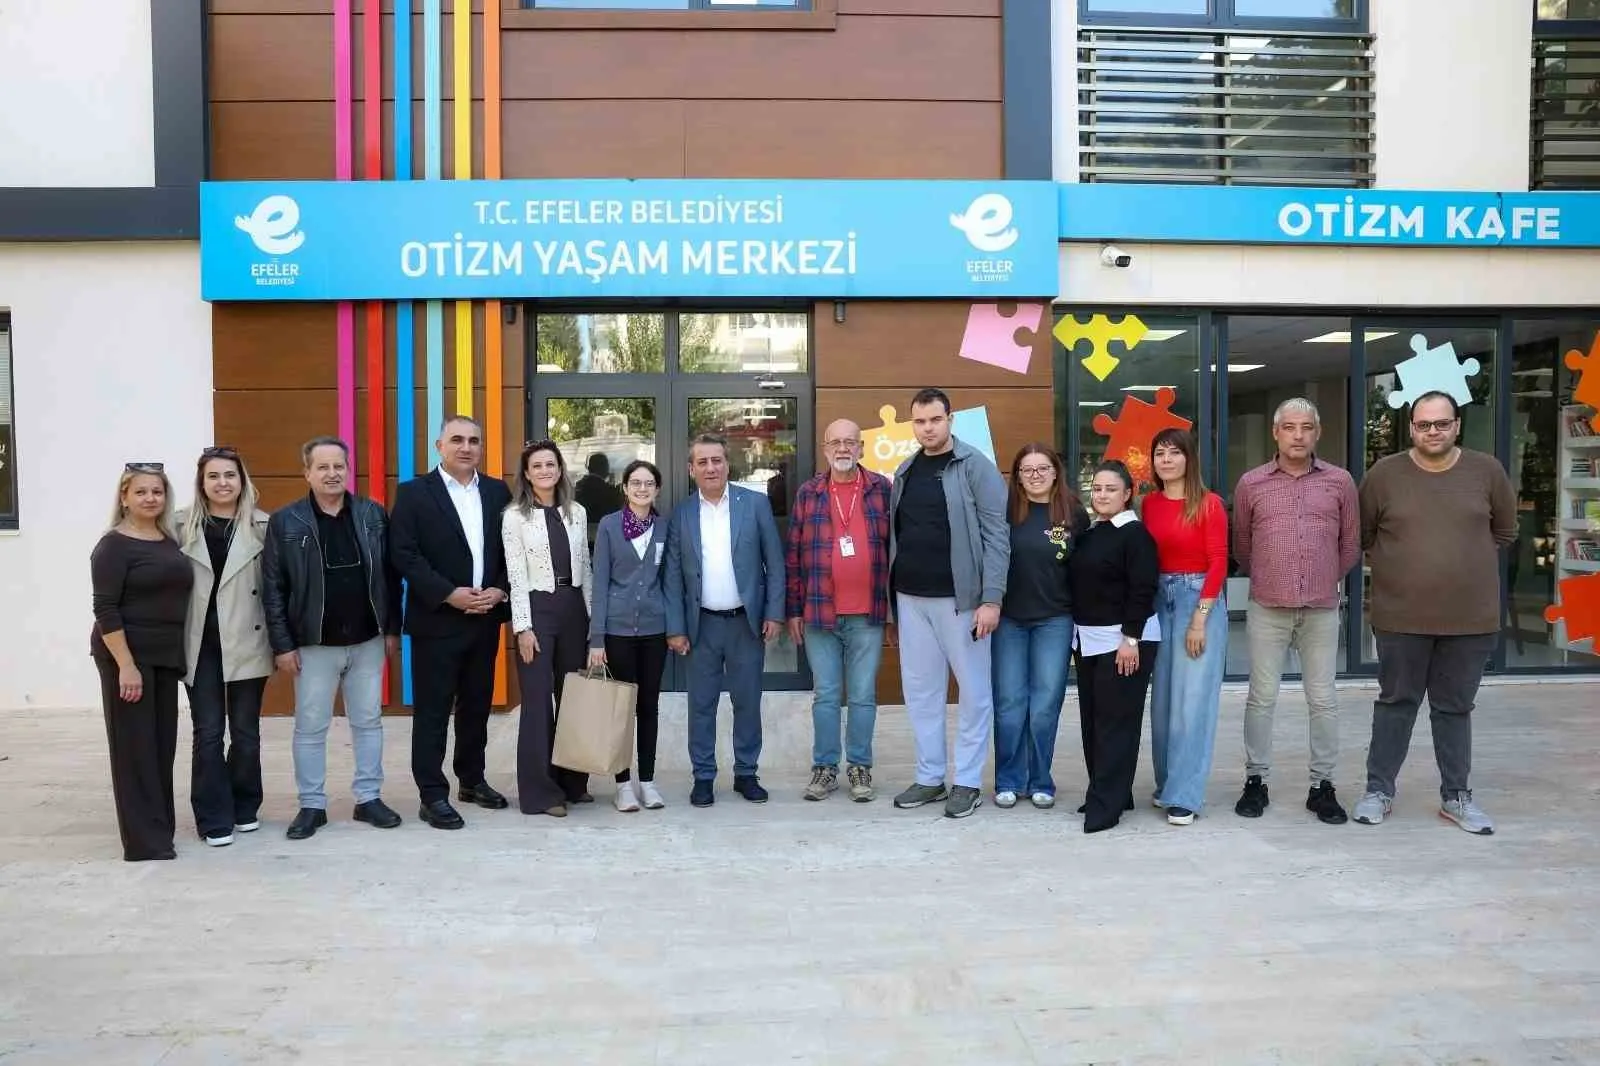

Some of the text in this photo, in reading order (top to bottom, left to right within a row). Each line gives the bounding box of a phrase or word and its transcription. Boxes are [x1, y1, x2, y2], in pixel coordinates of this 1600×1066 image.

[474, 194, 783, 225] T.C. EFELER BELEDİYESİ
[1278, 195, 1560, 240] OTİZM KAFE
[251, 263, 299, 276] EFELER
[401, 231, 856, 284] OTİZM YAŞAM MERKEZİ
[967, 260, 1013, 273] EFELER
